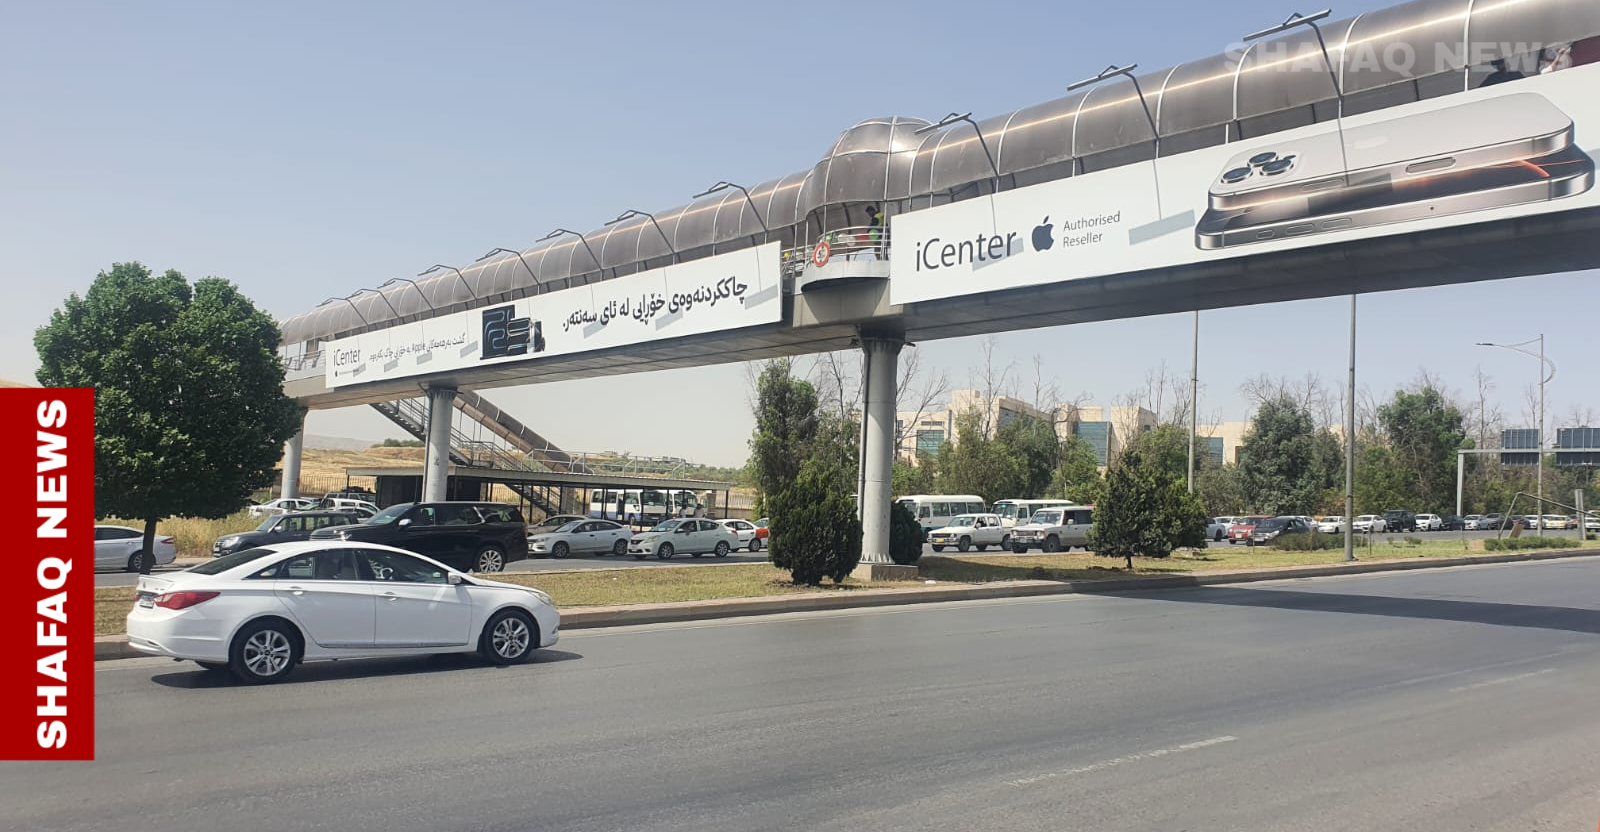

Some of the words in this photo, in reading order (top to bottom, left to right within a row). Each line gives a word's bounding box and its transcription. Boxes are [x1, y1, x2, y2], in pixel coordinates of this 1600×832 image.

[1063, 210, 1121, 232] Authorised
[1062, 232, 1103, 248] Reseller
[915, 231, 1017, 272] iCenter
[600, 299, 617, 326] ئای
[619, 297, 630, 317] لە
[333, 348, 361, 366] iCenter
